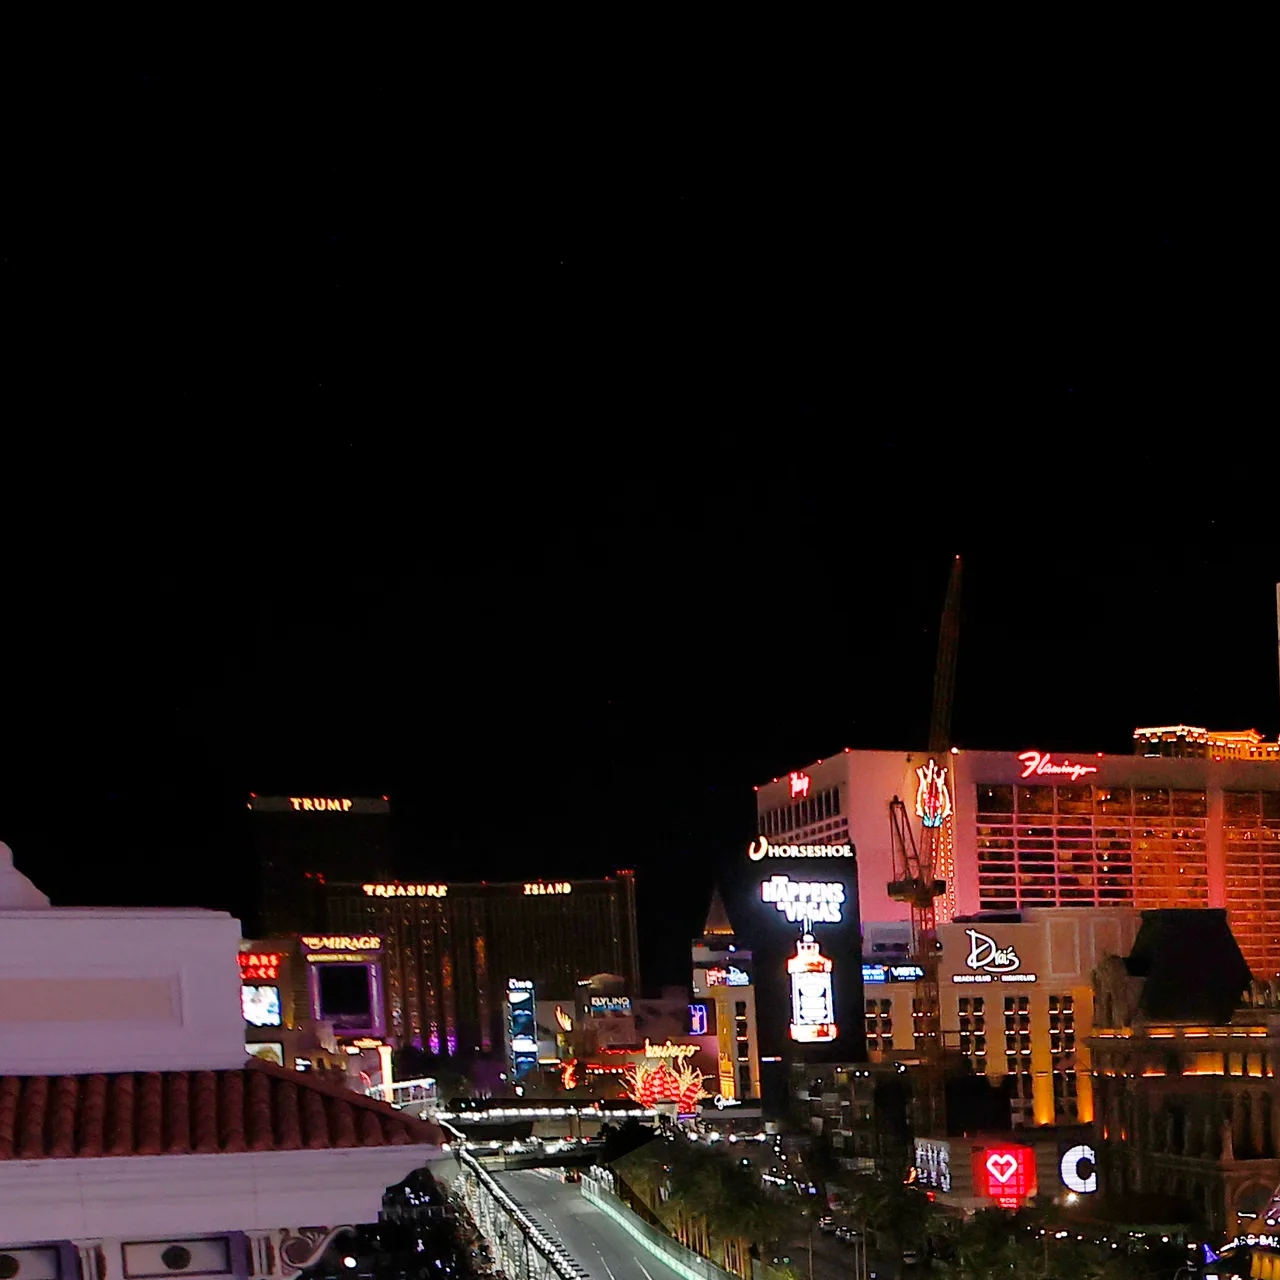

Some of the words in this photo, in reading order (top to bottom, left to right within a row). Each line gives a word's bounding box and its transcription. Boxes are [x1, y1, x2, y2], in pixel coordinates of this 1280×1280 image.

[1018, 751, 1097, 781] Flamingo
[290, 797, 352, 811] TRUMP
[767, 845, 853, 858] HORSESHOE
[362, 884, 448, 898] TREASURE
[523, 882, 573, 895] ISLAND
[762, 881, 845, 903] HAPPENS
[783, 901, 842, 923] VEGAS
[321, 936, 382, 951] MIRAGE
[966, 929, 1021, 973] Drai's
